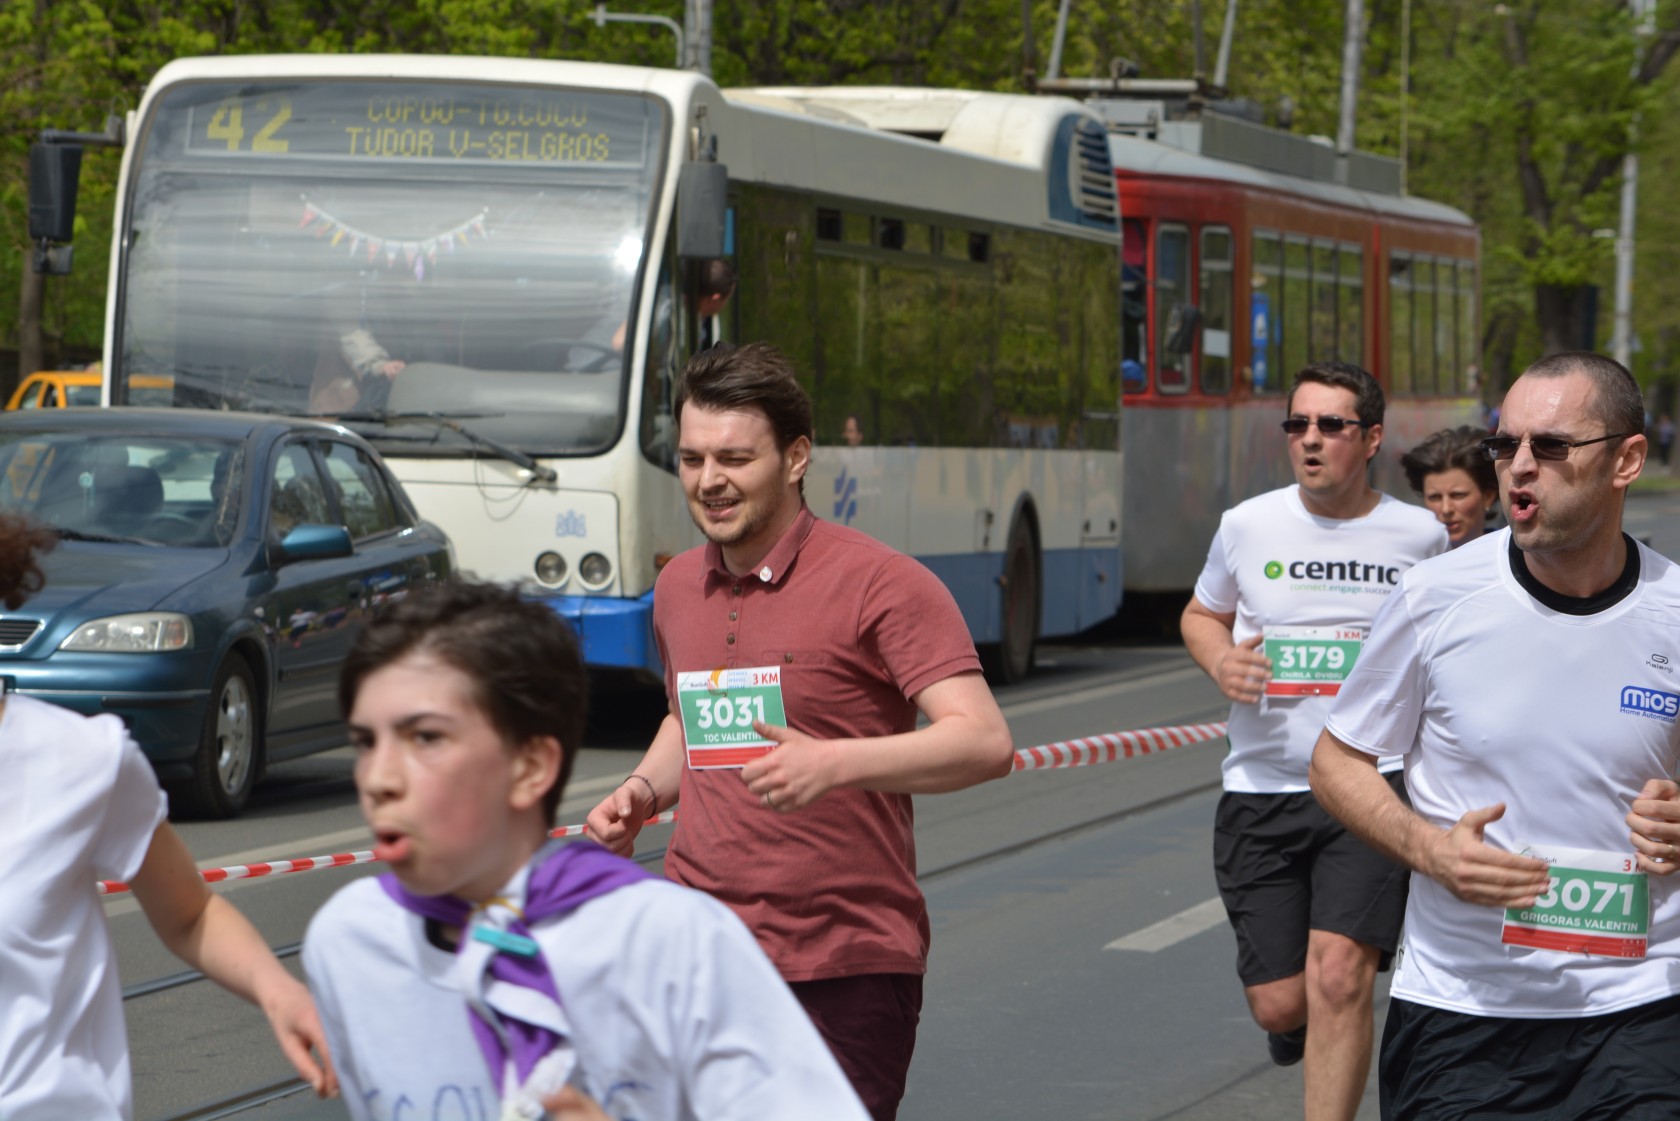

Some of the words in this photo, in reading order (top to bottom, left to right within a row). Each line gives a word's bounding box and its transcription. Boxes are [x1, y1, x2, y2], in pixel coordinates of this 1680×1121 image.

[207, 97, 293, 153] 42
[449, 129, 609, 161] V-SELGROS
[1289, 560, 1399, 585] centric
[1335, 631, 1341, 640] 3
[1344, 631, 1360, 640] KM
[1279, 646, 1345, 669] 3179
[753, 674, 759, 685] 3
[761, 673, 778, 684] KM
[696, 696, 765, 728] 3031
[1620, 708, 1640, 717] Home
[704, 733, 719, 743] TOC
[1623, 859, 1631, 872] 3
[1534, 877, 1634, 916] 3071
[1520, 912, 1581, 927] GRIGORAS
[1584, 919, 1638, 932] VALENTIN
